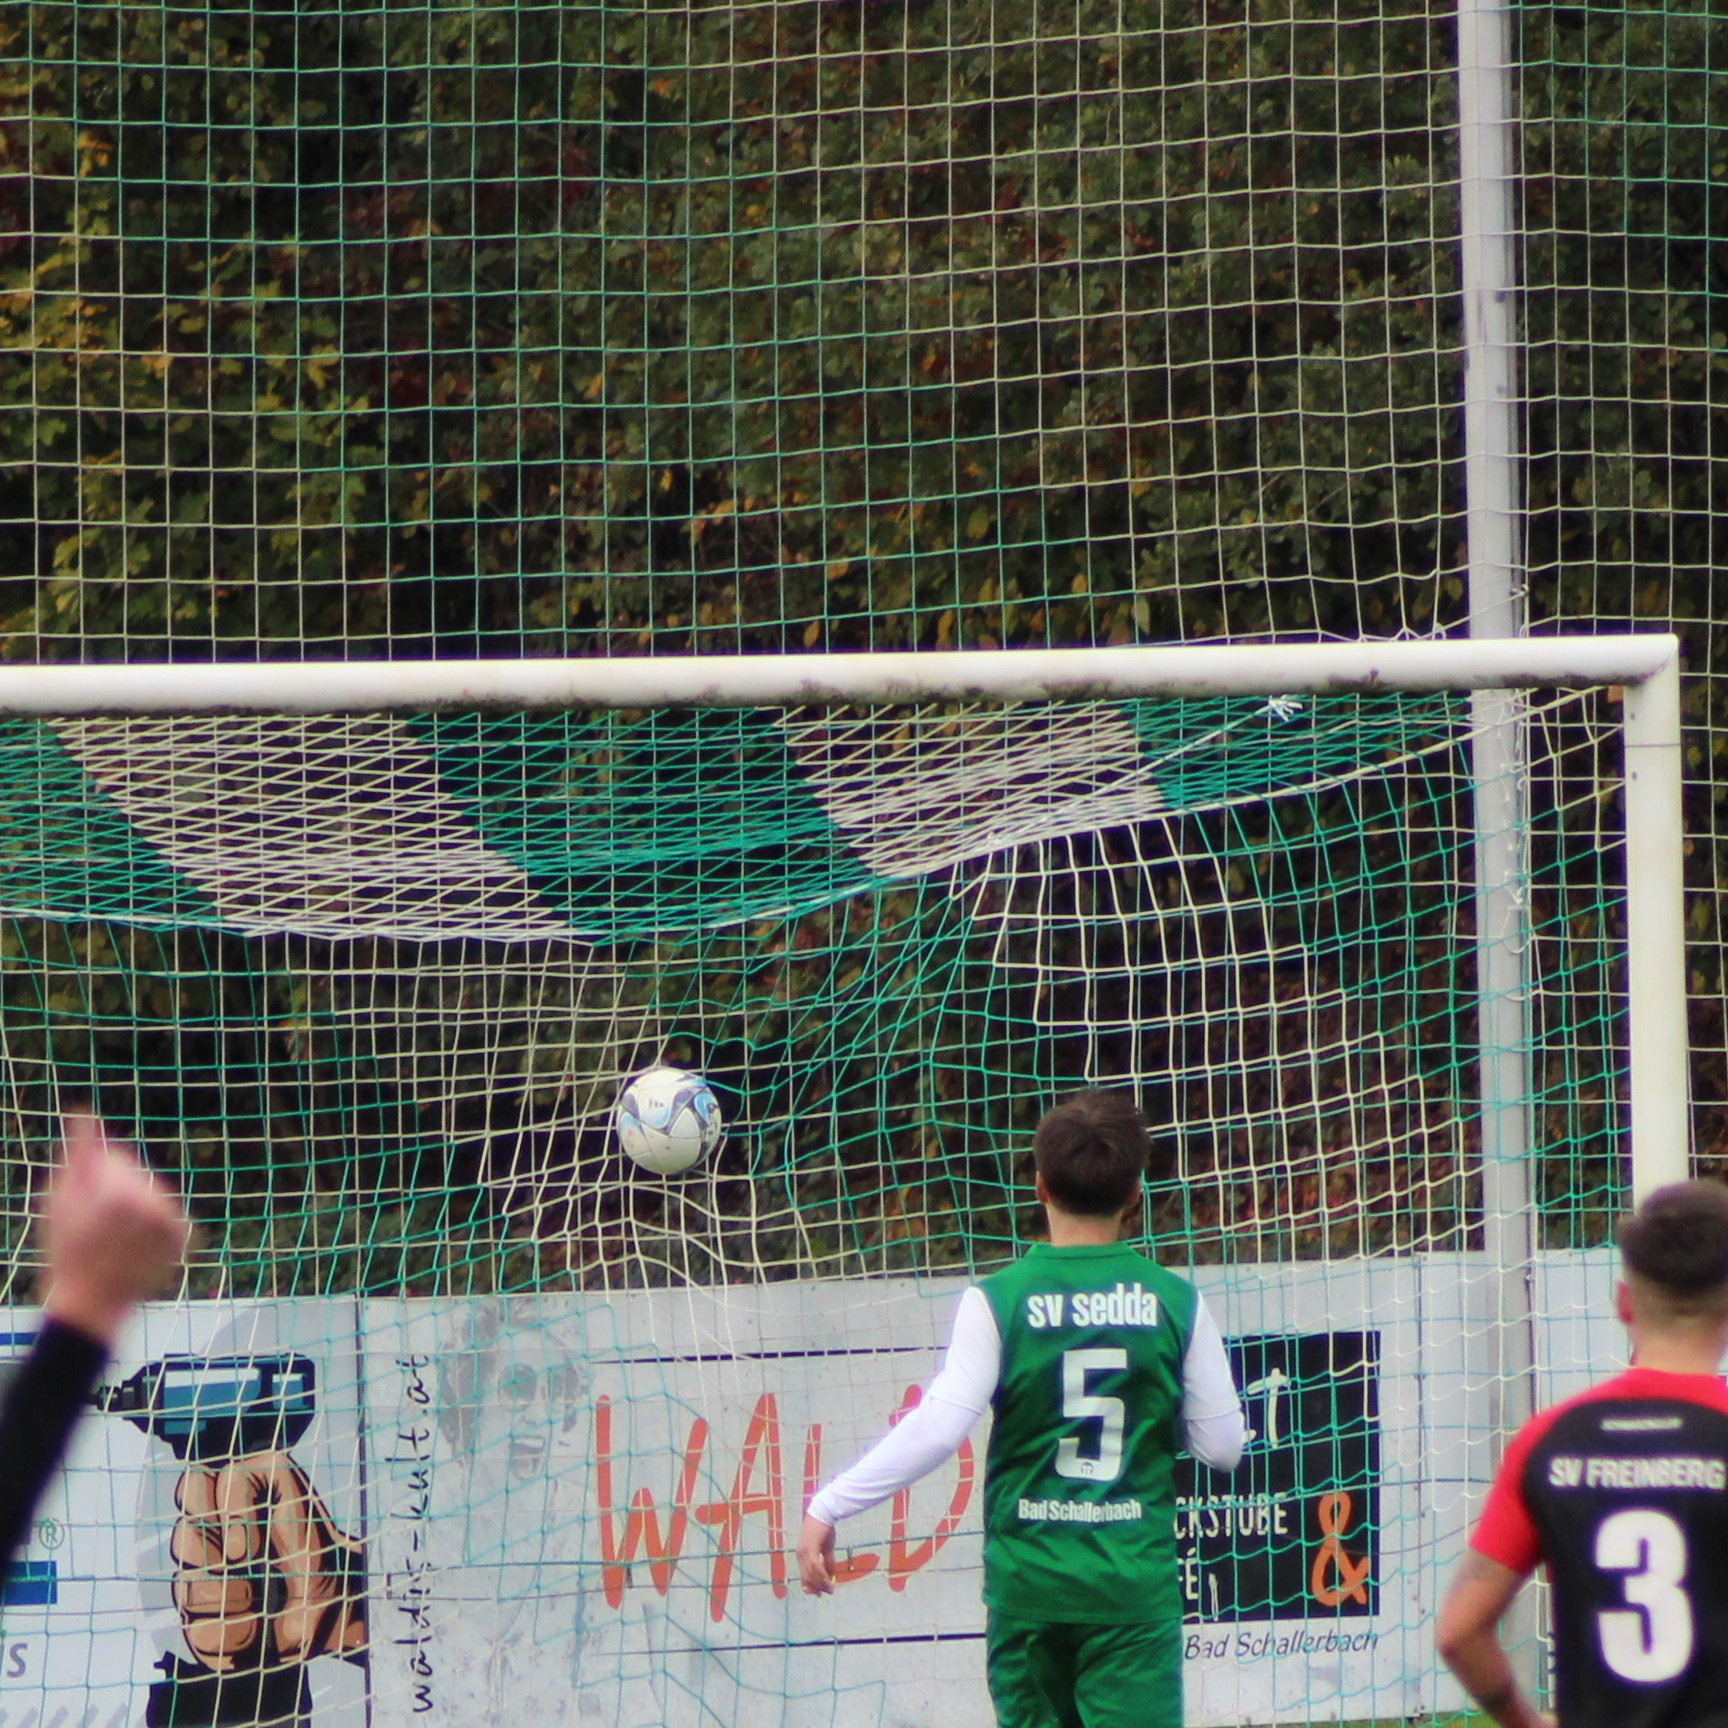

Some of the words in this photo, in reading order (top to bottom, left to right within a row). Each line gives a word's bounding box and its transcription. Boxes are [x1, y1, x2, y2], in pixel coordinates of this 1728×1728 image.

[1072, 1282, 1158, 1328] sedda
[1054, 1347, 1128, 1482] 5
[1547, 1457, 1584, 1488] SV
[1585, 1457, 1727, 1490] FREINBERG
[594, 1383, 975, 1624] WALD
[1018, 1498, 1047, 1521] Bad
[1048, 1498, 1142, 1524] Schallerbach
[1173, 1491, 1288, 1540] CKSTUBE
[1595, 1509, 1694, 1683] 3
[1184, 1633, 1230, 1660] Bad
[1235, 1628, 1379, 1656] Schallerbach
